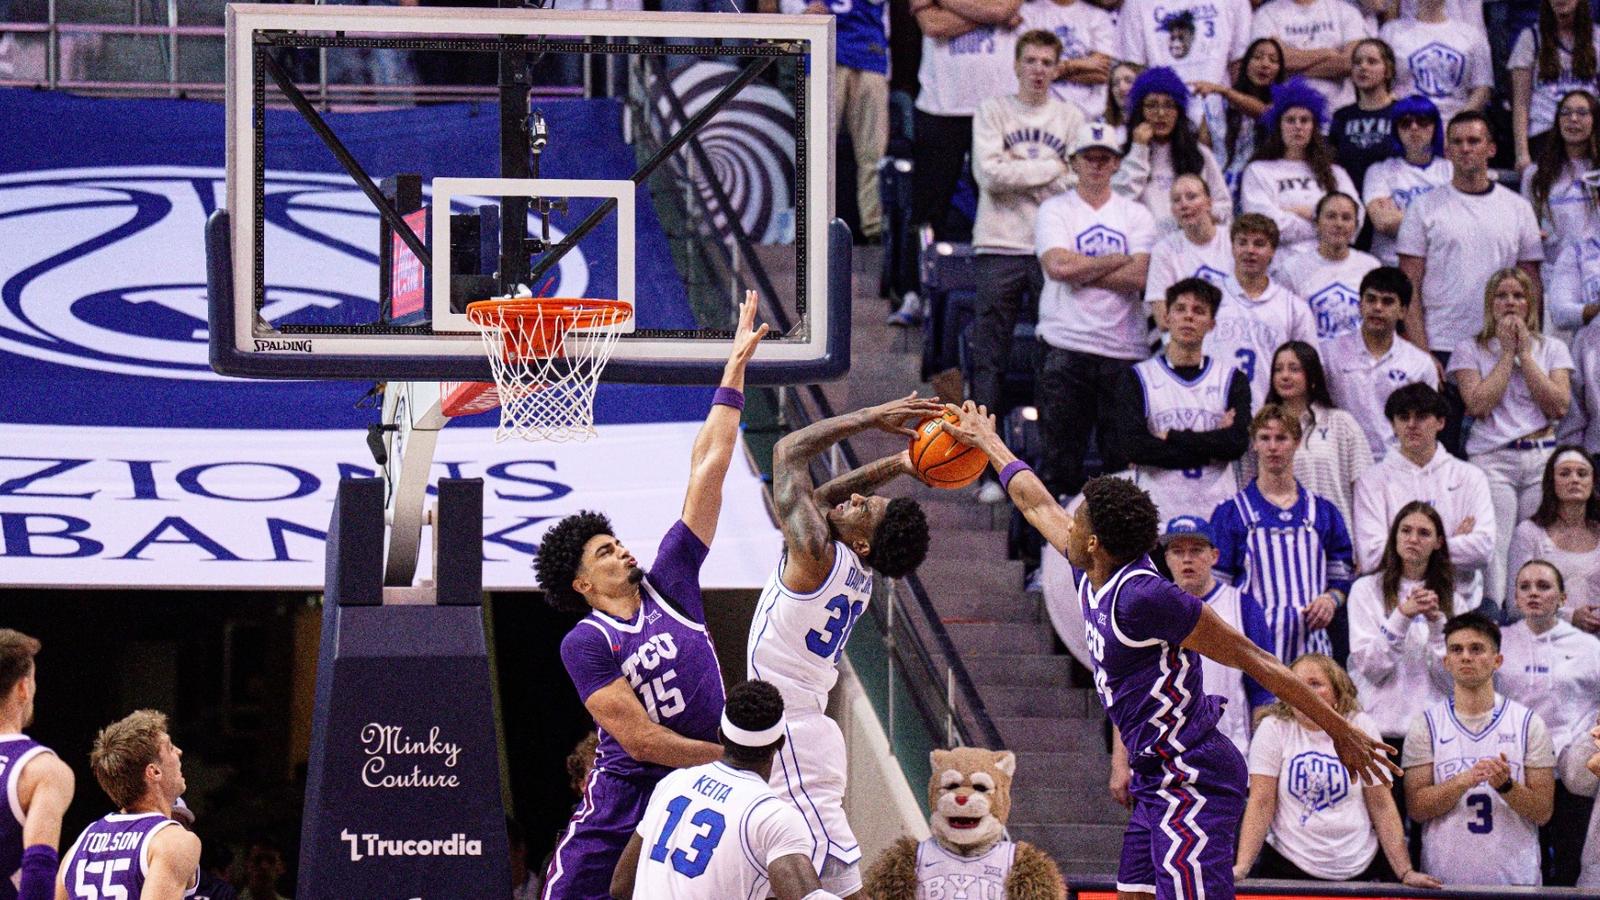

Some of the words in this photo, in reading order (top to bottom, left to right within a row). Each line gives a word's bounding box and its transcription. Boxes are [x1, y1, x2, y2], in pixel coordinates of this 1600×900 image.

[253, 339, 313, 353] SPALDING
[621, 632, 678, 689] TCU
[640, 669, 686, 724] 15
[361, 722, 462, 767] Minky
[361, 756, 460, 788] Couture
[692, 774, 733, 803] KEITA
[1466, 793, 1493, 834] 3
[82, 831, 143, 853] TOOLSON
[362, 833, 482, 856] Trucordia
[650, 795, 726, 879] 13
[75, 858, 131, 900] 55
